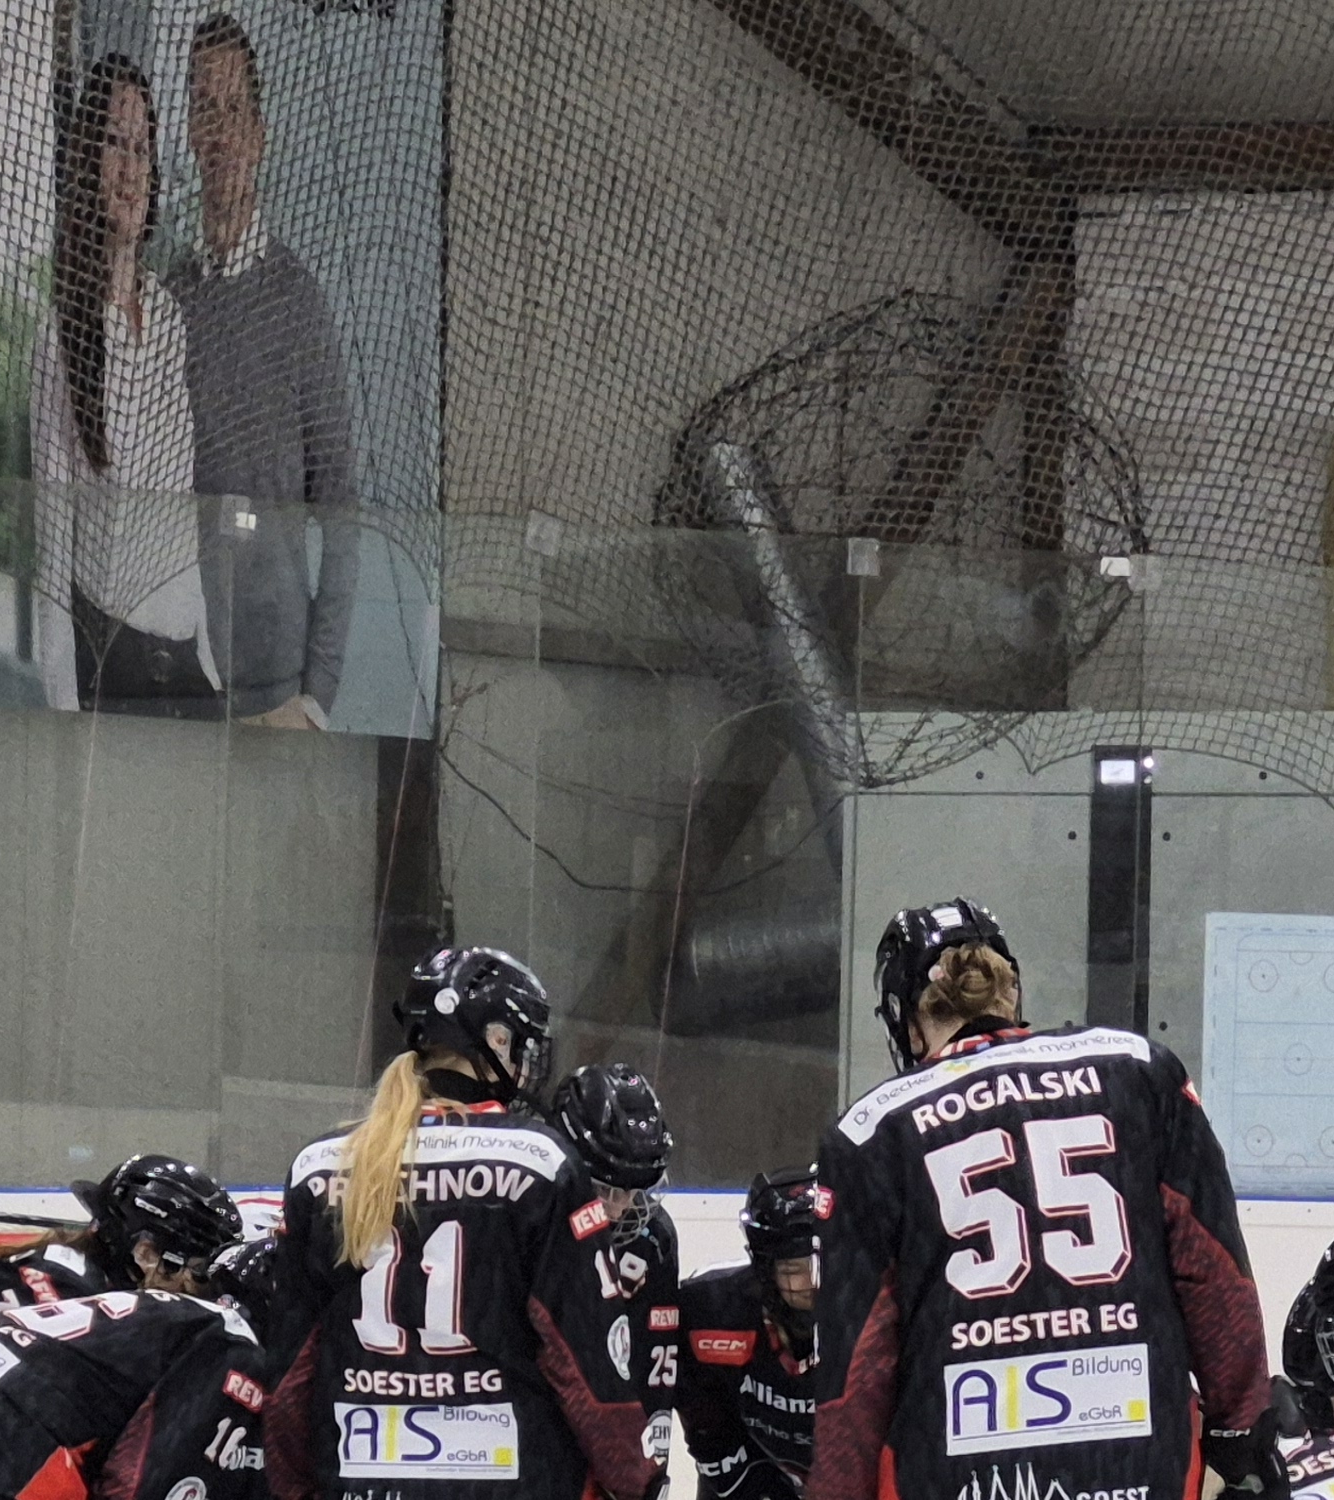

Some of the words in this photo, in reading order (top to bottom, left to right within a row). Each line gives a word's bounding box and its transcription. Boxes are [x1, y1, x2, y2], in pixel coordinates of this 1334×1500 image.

[912, 1066, 1102, 1134] ROGALSKI
[417, 1135, 458, 1149] Klinik
[463, 1134, 551, 1161] Möhnesee
[307, 1165, 535, 1207] PRHNOW
[924, 1114, 1131, 1300] 55
[352, 1220, 479, 1355] 11
[698, 1338, 747, 1353] CCM
[951, 1307, 1091, 1350] SOESTER
[1099, 1303, 1138, 1333] EG
[344, 1368, 456, 1398] SOESTER
[463, 1368, 503, 1393] EG
[648, 1345, 679, 1386] 25
[952, 1360, 1072, 1436] AIS
[1071, 1355, 1143, 1376] Bildung
[342, 1405, 443, 1462] AIS
